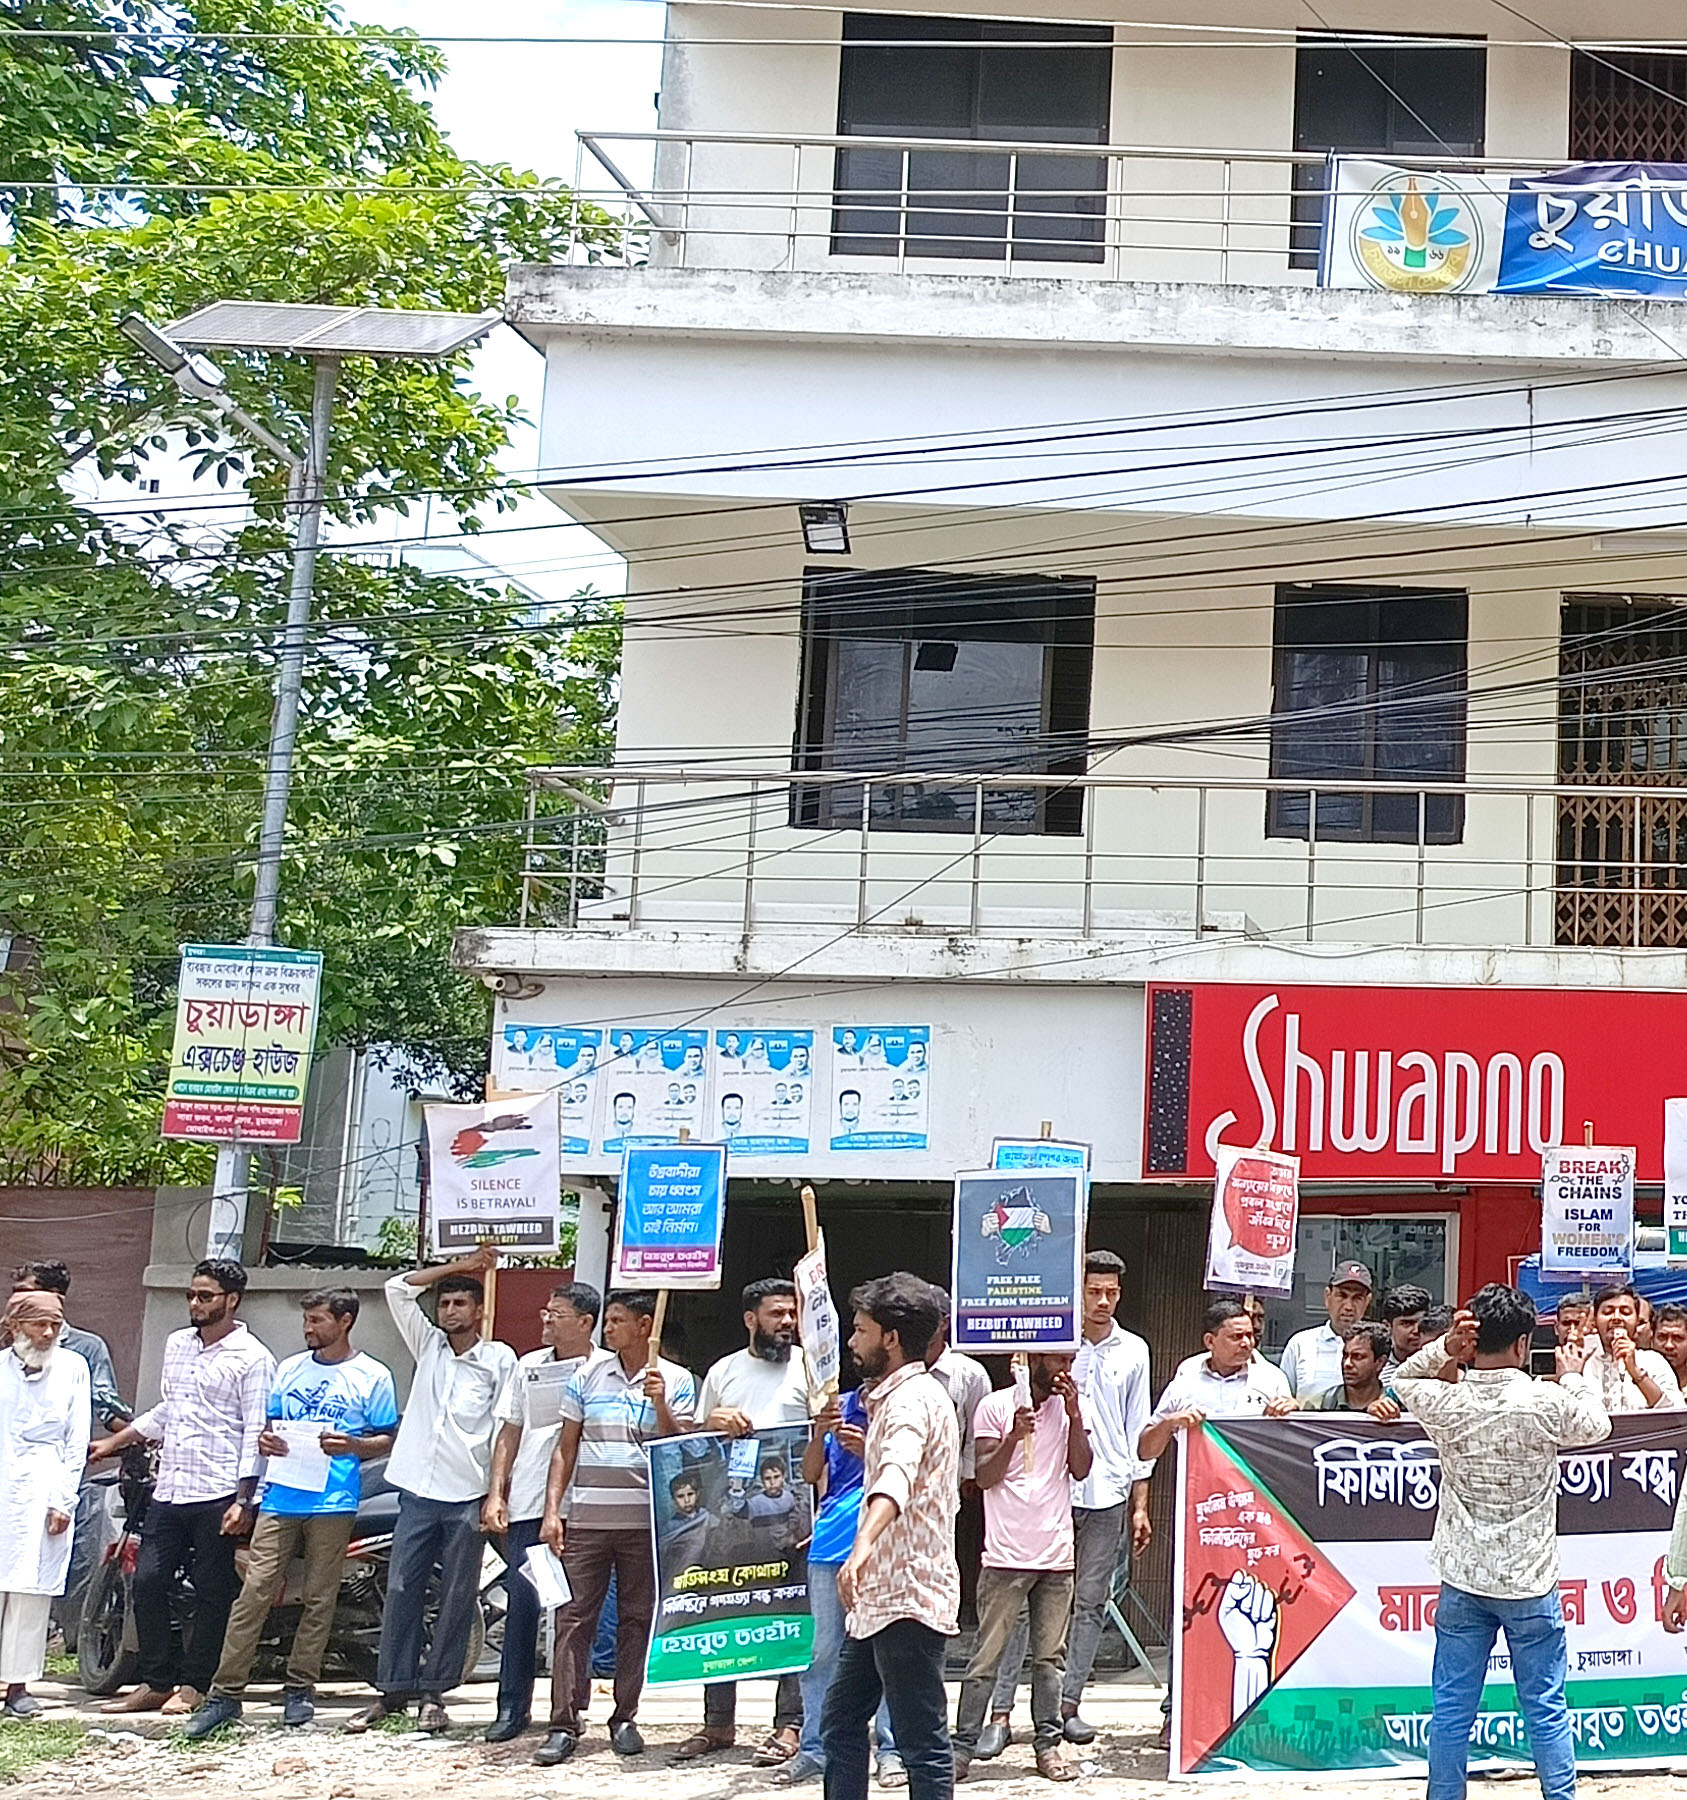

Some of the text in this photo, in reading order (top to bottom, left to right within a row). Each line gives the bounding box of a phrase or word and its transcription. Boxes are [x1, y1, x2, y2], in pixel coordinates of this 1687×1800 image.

[184, 998, 311, 1036] চুয়াডাঙ্গা
[253, 1039, 300, 1081] হাউজ
[1205, 994, 1566, 1174] Shwapno
[648, 1163, 702, 1179] উগ্রবাদীরা
[1559, 1161, 1623, 1174] BREAK
[471, 1179, 521, 1190] SILENCE
[1577, 1176, 1604, 1185] THE
[648, 1184, 702, 1198] চায় ধ্বংস
[1559, 1187, 1623, 1200] CHAINS
[457, 1197, 536, 1210] IS BETRAYAL!
[666, 1203, 704, 1216] আমরা
[1565, 1209, 1613, 1221] ISLAM
[643, 1219, 661, 1234] চাই
[1578, 1223, 1601, 1232] FOR
[1552, 1234, 1627, 1246] WOMEN'S
[1558, 1247, 1620, 1257] FREEDOM
[987, 1275, 1040, 1284] FREE FREE
[987, 1286, 1043, 1295] PALESTINE
[961, 1296, 1069, 1307] FREE FROM WESTERN
[967, 1316, 1062, 1330] HEZBUT TAWHEED
[1019, 1330, 1038, 1339] CITY
[1619, 1449, 1678, 1506] বন্ধ
[1238, 1510, 1255, 1525] এক
[1264, 1544, 1280, 1558] কর
[732, 1561, 789, 1587] কোথায়?
[752, 1589, 771, 1605] বন্ধ
[1601, 1577, 1637, 1625] ও
[662, 1621, 801, 1656] হেযবুত তওহীদ
[1576, 1649, 1632, 1673] চুয়াডাঙ্গা
